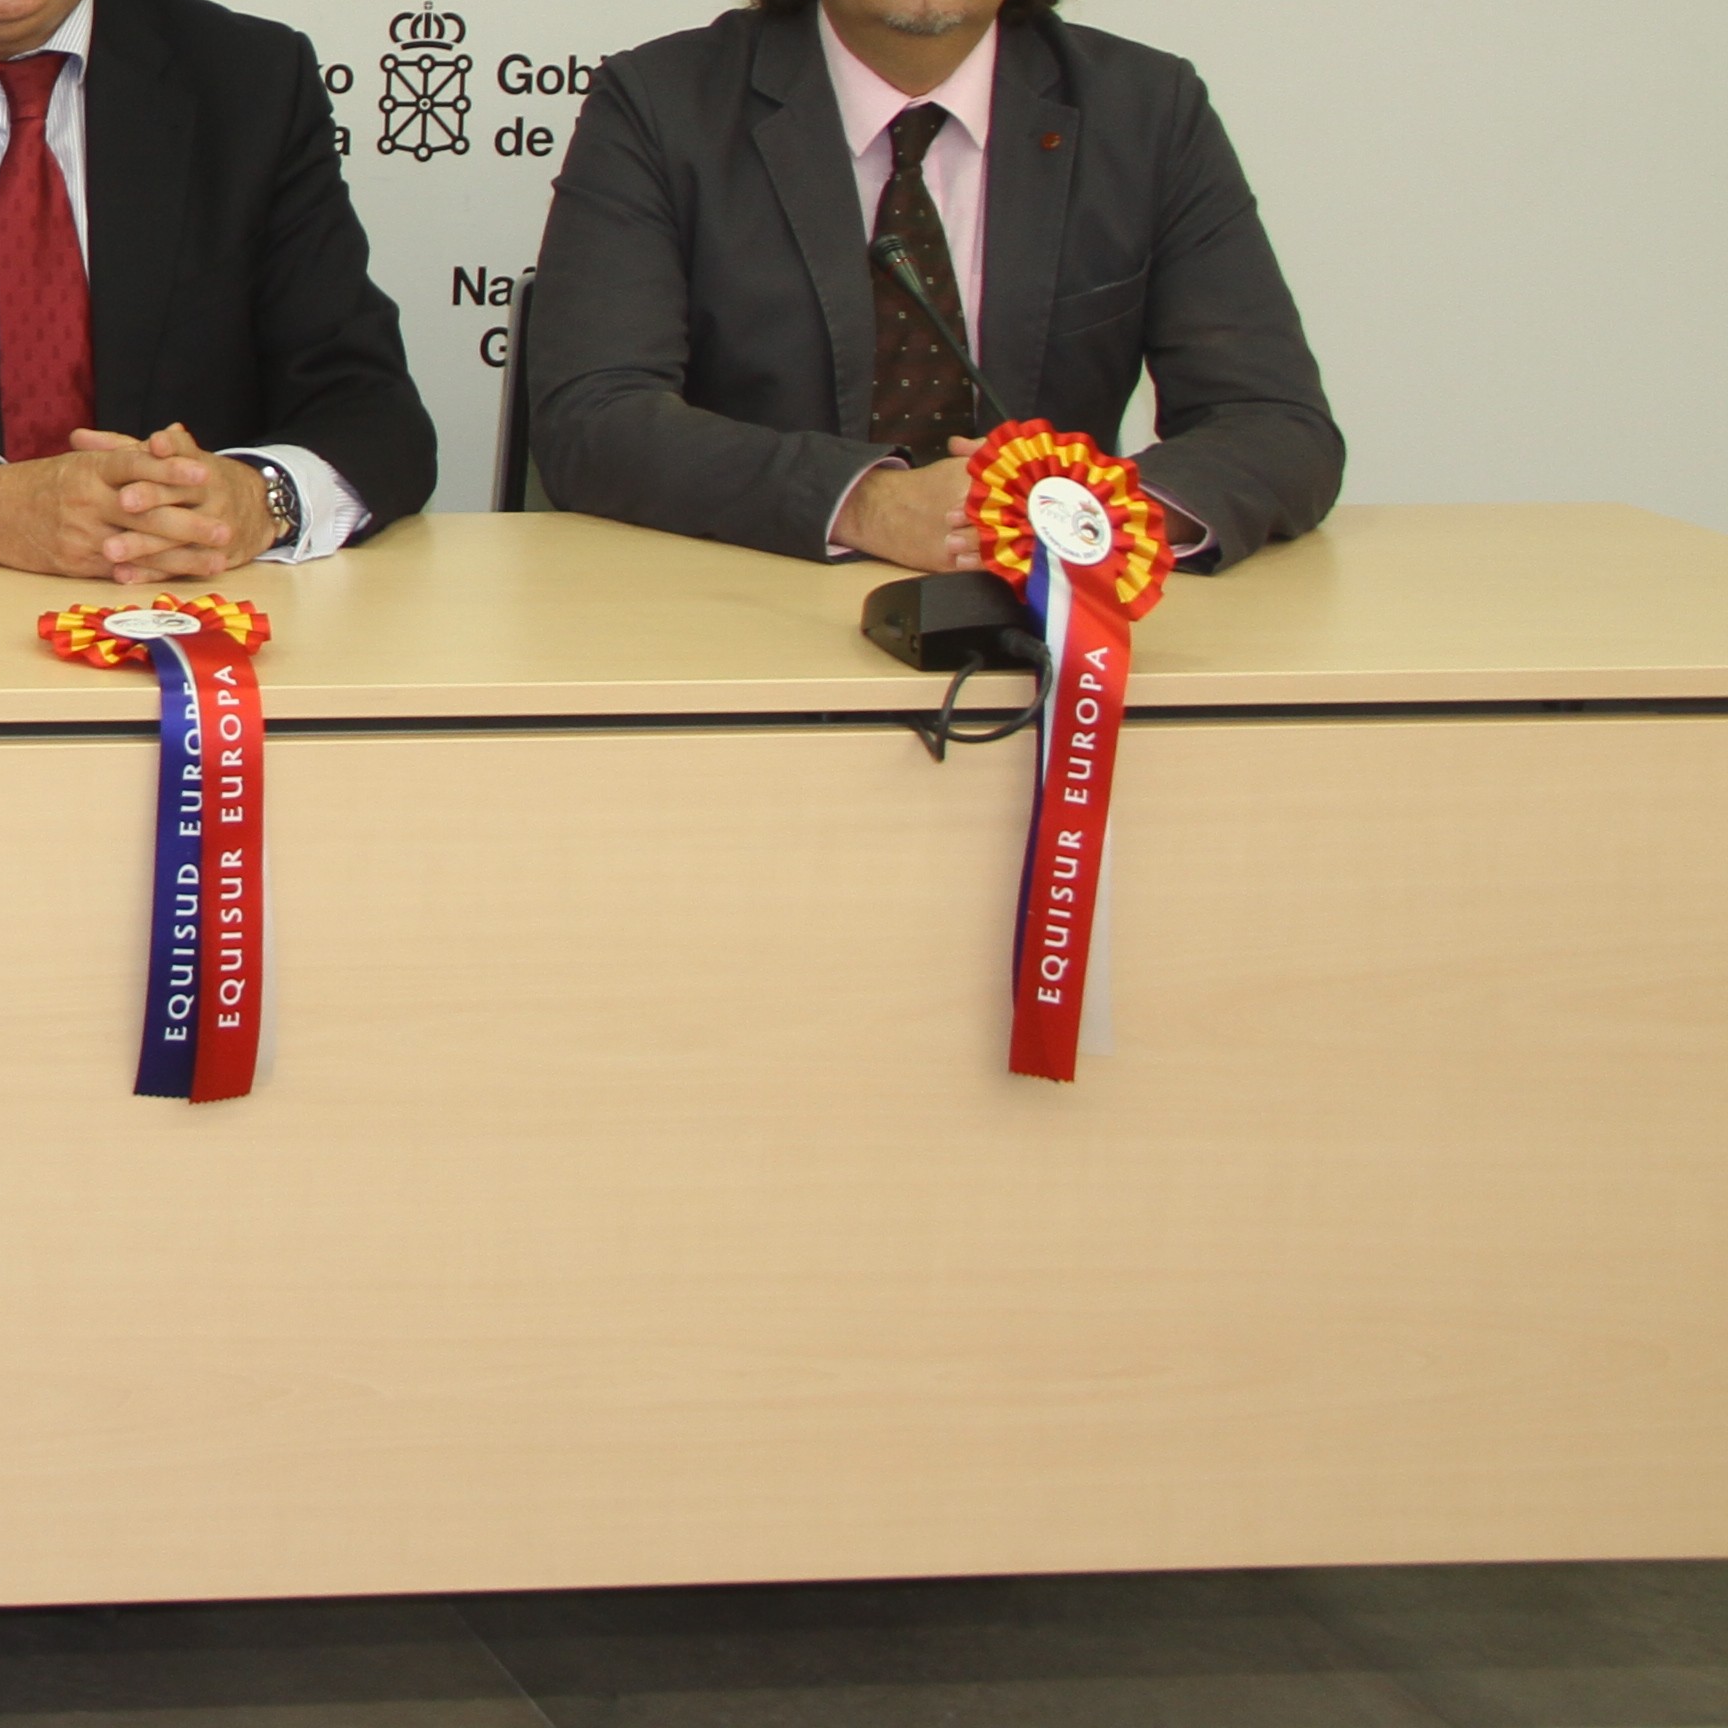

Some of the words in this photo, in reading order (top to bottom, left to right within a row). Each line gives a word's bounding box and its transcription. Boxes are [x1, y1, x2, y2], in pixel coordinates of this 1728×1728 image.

[494, 116, 554, 157] de
[213, 665, 244, 823] EUROPA
[1037, 829, 1083, 1006] EQUISUR
[1064, 646, 1110, 806] EUROPA
[164, 862, 201, 1042] EQUISUD
[217, 847, 246, 1029] EQUISUR
